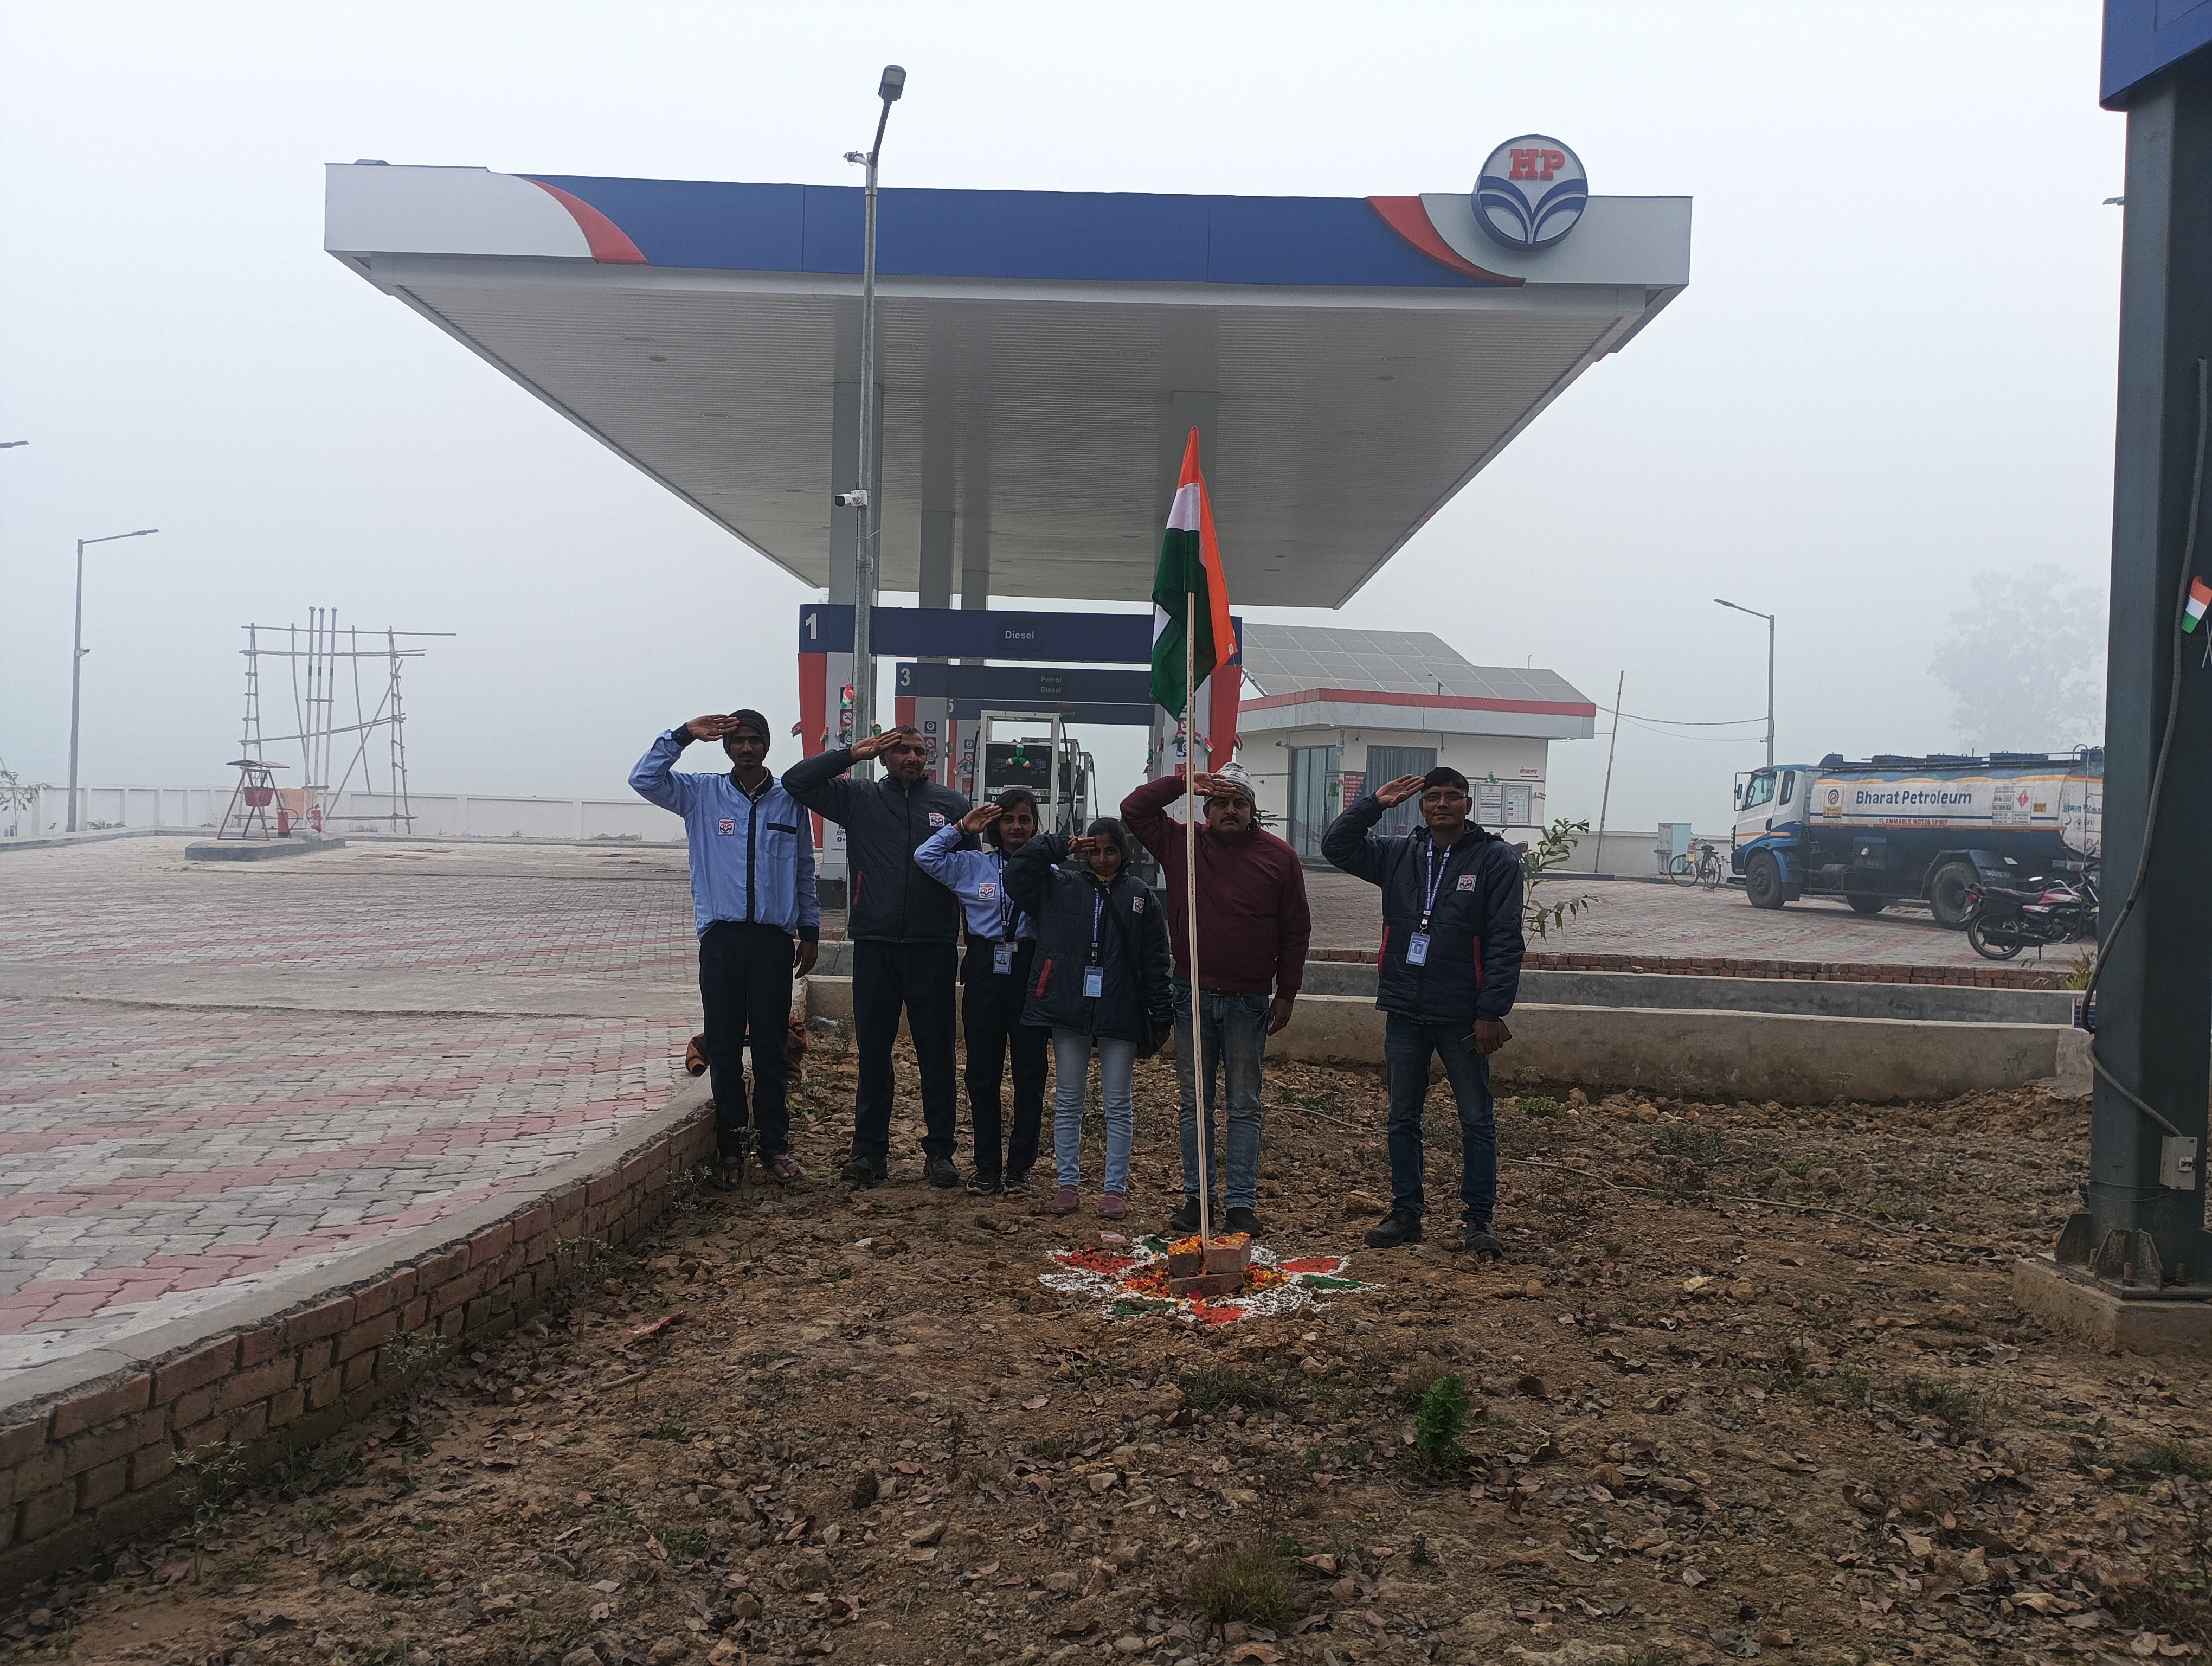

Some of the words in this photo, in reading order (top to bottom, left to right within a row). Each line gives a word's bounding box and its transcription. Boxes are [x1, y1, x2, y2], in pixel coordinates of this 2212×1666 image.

[1508, 148, 1565, 180] HP
[805, 613, 817, 640] 1
[1005, 630, 1034, 639] Diesel
[900, 668, 911, 687] 3
[1856, 791, 1899, 804] Bharat
[1902, 790, 1972, 804] Petroleum
